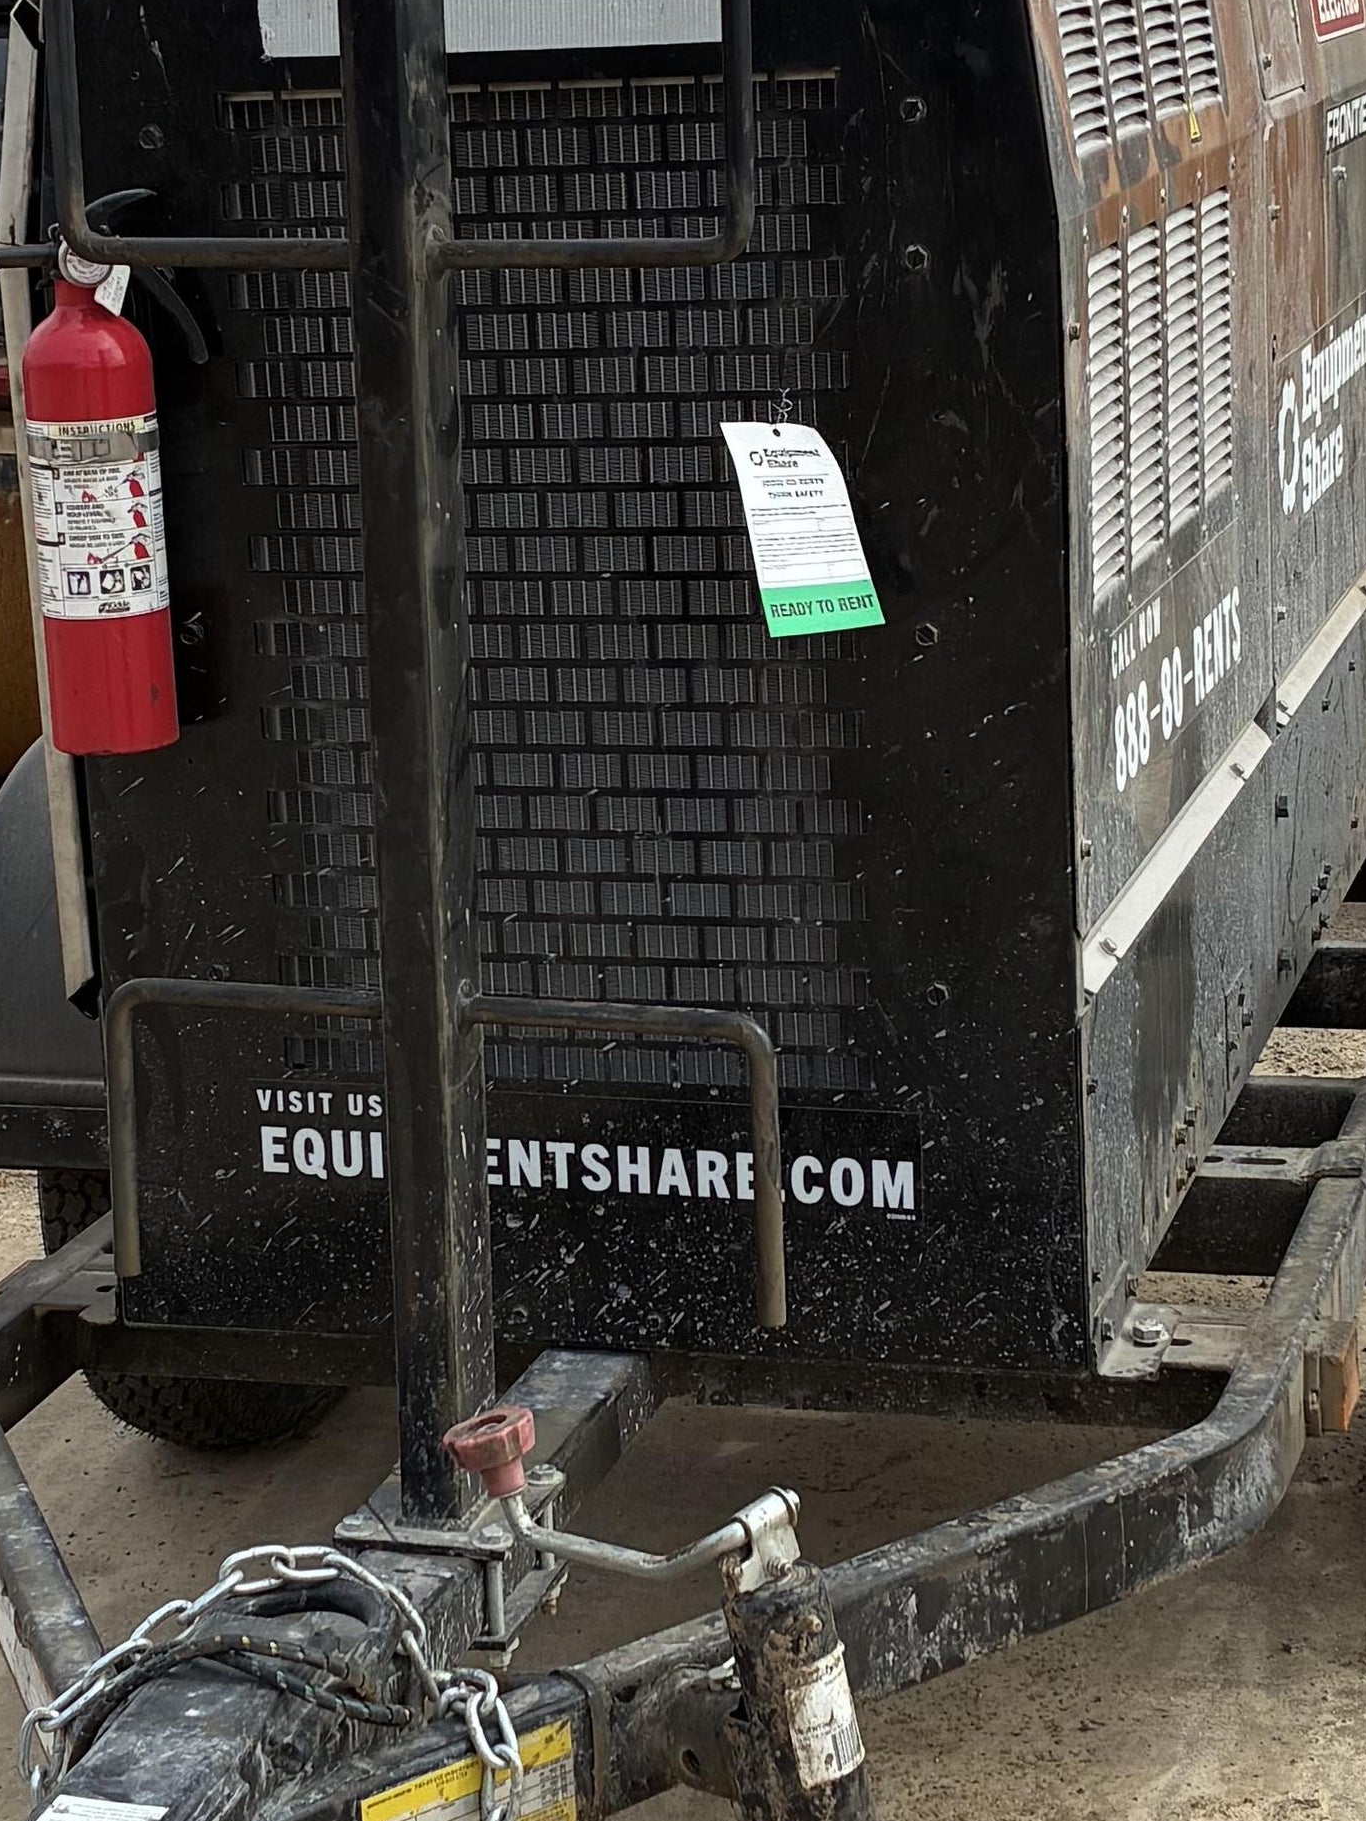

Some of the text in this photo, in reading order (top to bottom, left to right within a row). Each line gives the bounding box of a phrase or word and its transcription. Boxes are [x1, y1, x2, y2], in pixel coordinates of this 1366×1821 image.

[1301, 423, 1344, 514] Share
[769, 594, 875, 617] READY TO RENT
[1111, 596, 1161, 680] CALL NOW
[1114, 586, 1242, 792] 888-80-RENTS
[256, 1088, 383, 1118] VISIT US
[260, 1125, 915, 1211] EQUIENTSHARE.COM
